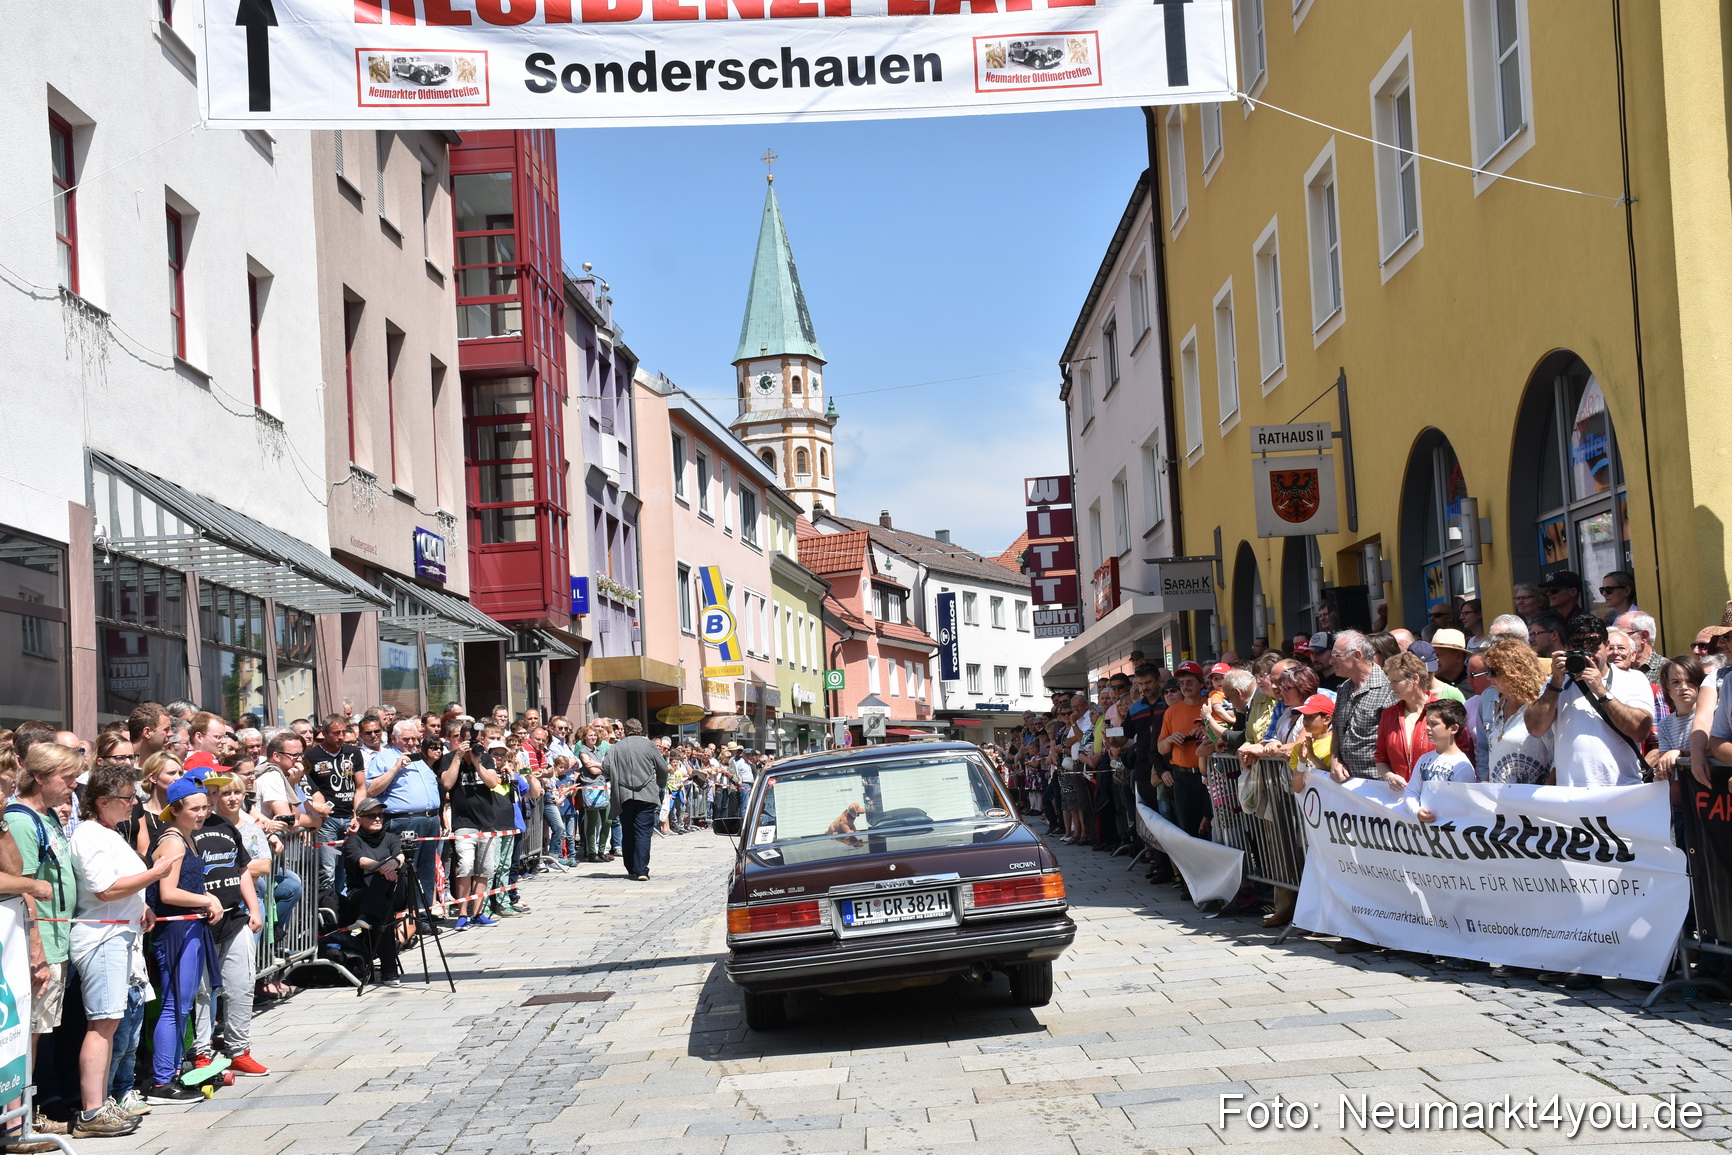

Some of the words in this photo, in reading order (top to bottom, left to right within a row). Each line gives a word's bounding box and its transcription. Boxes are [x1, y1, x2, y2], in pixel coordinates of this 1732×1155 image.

[524, 46, 943, 94] Sonderschauen
[985, 72, 1031, 83] Neumarkter
[1032, 66, 1092, 83] Oldtimertreffen
[368, 86, 416, 99] Neumarkter
[418, 86, 480, 100] Oldtimertreffen
[1258, 430, 1313, 445] RATHAUS
[1316, 429, 1324, 441] II
[1164, 578, 1199, 590] SARAH
[1202, 576, 1210, 588] K
[705, 614, 723, 634] B
[949, 600, 957, 640] TAILOR
[1034, 610, 1077, 625] WITT
[1035, 625, 1079, 637] WEIDEN
[1324, 811, 1635, 863] neumarktaktuell
[1009, 861, 1036, 869] CROWN
[203, 880, 221, 891] ITY
[881, 880, 909, 889] TOYOTA
[1338, 859, 1358, 875] DAS
[1359, 864, 1476, 891] NACHRICHTENPORTAL
[1480, 873, 1509, 891] FÜR
[1512, 876, 1646, 897] NEUMARKT/OPF.
[854, 900, 873, 919] EI
[883, 898, 903, 916] CR
[1351, 904, 1449, 929] www.neumarktaktuell.de
[1478, 920, 1620, 945] facebook.com/neumarktaktuell
